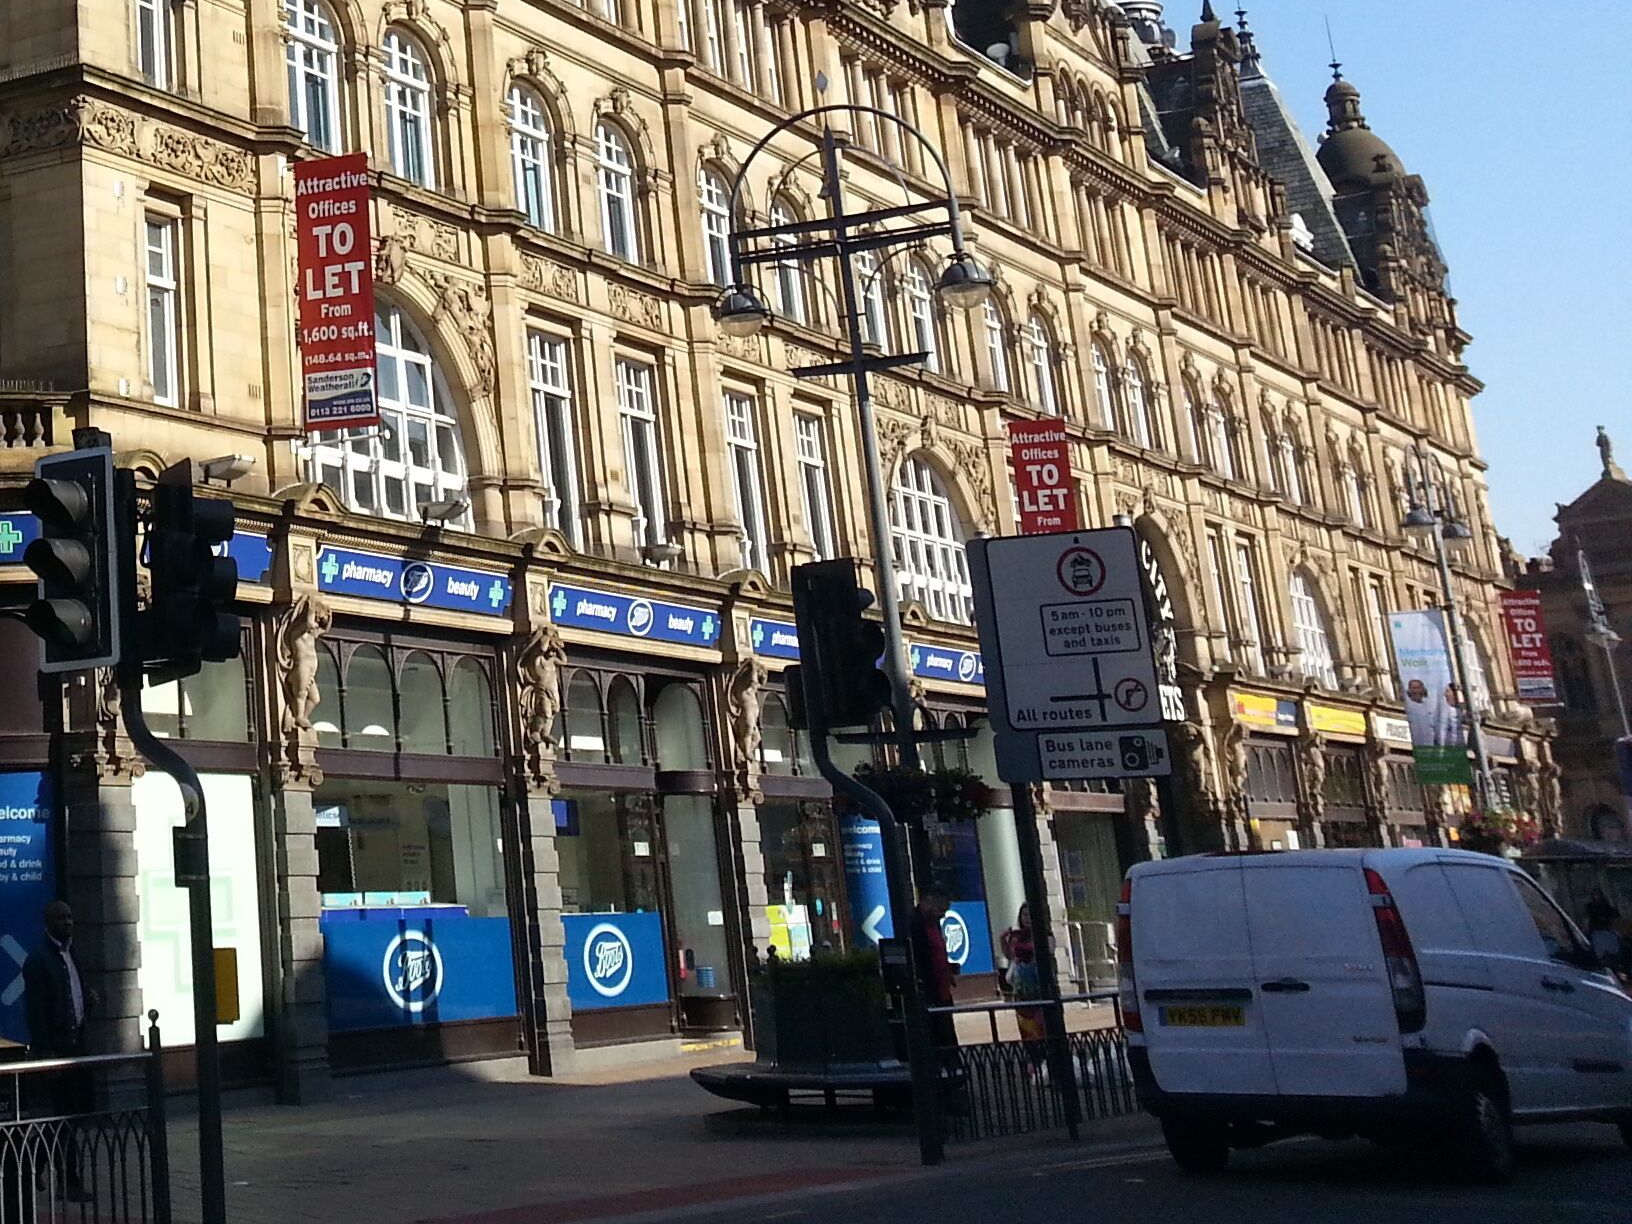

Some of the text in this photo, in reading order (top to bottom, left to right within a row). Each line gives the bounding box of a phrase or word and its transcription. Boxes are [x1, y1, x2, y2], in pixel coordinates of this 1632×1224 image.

[297, 171, 368, 196] Attractive
[308, 200, 357, 219] Offices
[312, 222, 355, 258] TO
[305, 261, 365, 301] LET
[320, 303, 352, 318] From
[303, 321, 374, 344] 1,600 sq.ft.
[308, 373, 354, 384] Sanderson
[1011, 430, 1066, 445] Attractive
[1021, 447, 1059, 461] Offices
[1025, 463, 1059, 487] TO
[1022, 487, 1068, 512] LET
[1036, 516, 1061, 526] From
[342, 560, 394, 588] pharmacy
[447, 577, 480, 600] beauty
[576, 599, 617, 622] pharmacy
[1049, 621, 1132, 636] except buses
[1512, 618, 1537, 632] TO
[1064, 634, 1121, 648] and taxis
[1511, 633, 1544, 648] LET
[1017, 707, 1093, 722] All routes
[1045, 738, 1113, 752] Bus lane
[1049, 757, 1115, 770] cameras
[19, 859, 43, 869] drink
[20, 871, 43, 881] child
